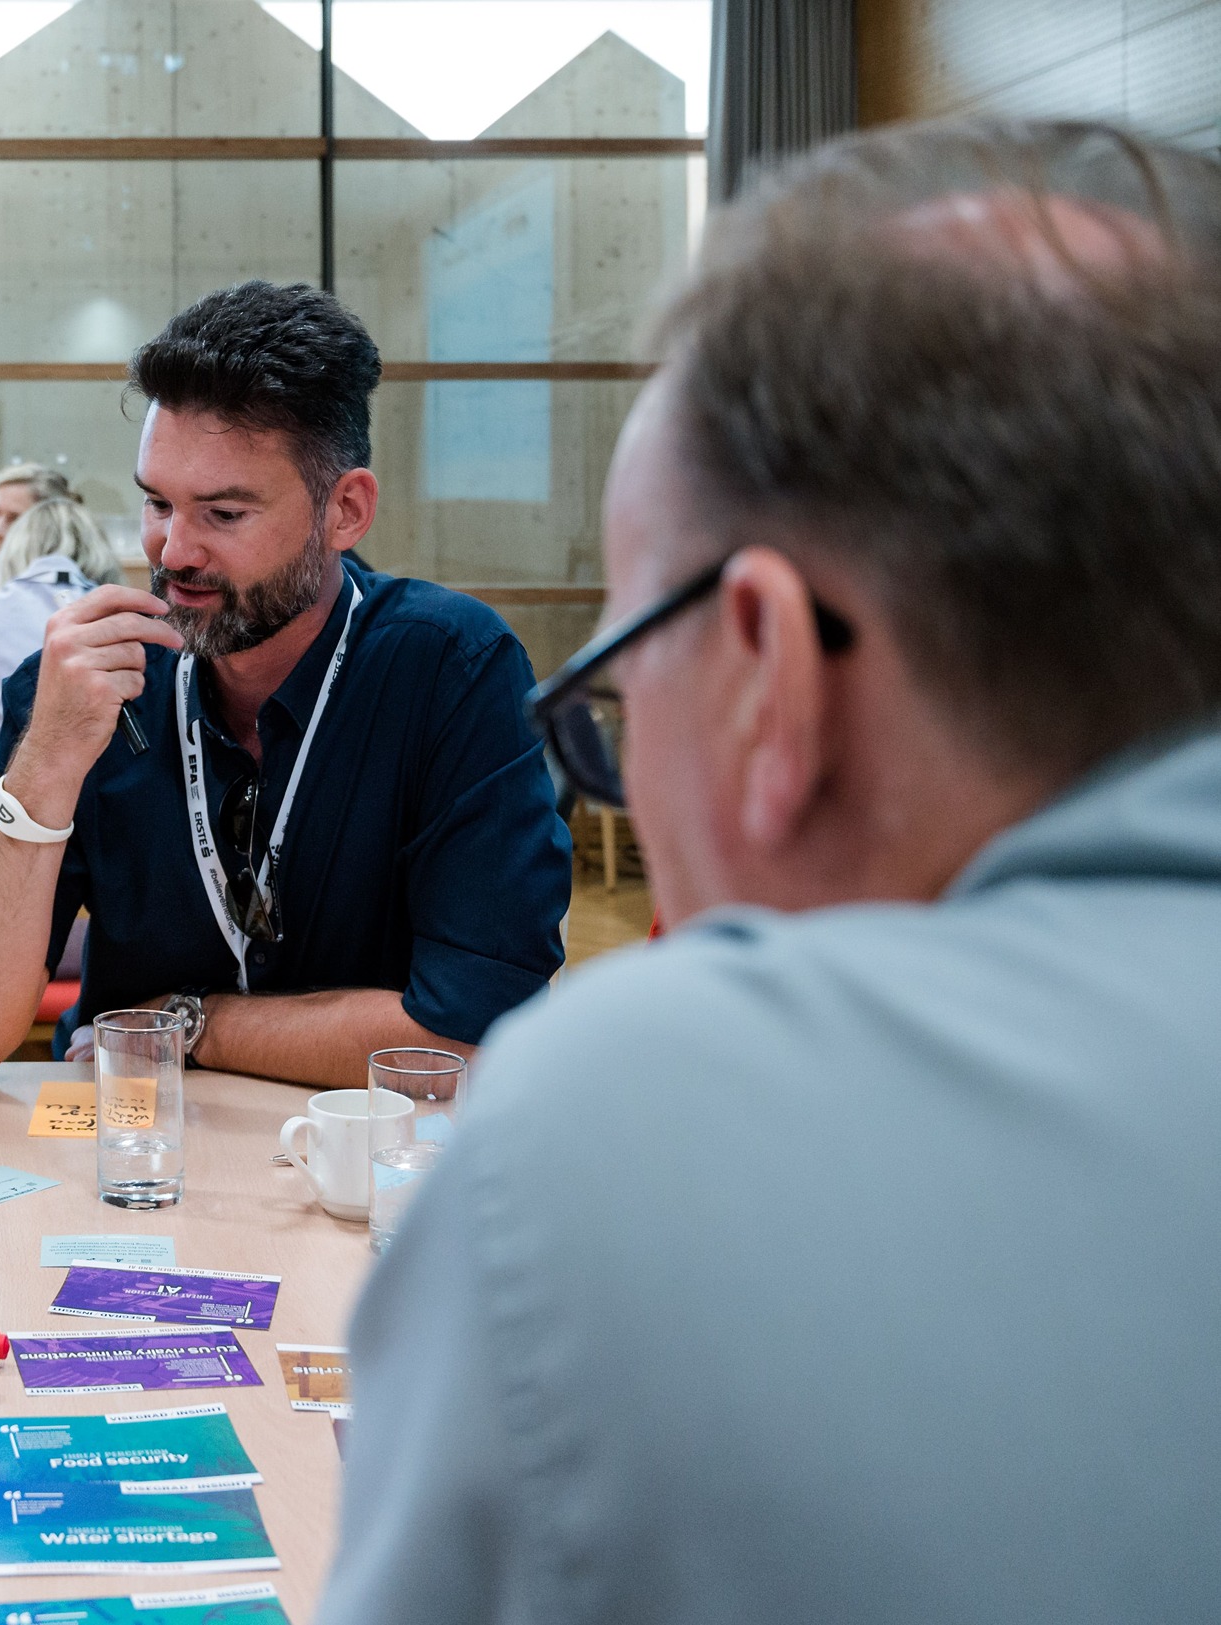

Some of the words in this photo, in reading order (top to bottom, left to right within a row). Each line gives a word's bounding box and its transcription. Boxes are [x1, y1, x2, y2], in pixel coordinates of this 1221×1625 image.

[188, 754, 198, 785] EFA
[194, 811, 208, 846] ERSTE
[209, 868, 237, 936] #believeineurope
[157, 1284, 183, 1294] AI
[181, 1292, 214, 1301] THREAT
[51, 1306, 95, 1316] INSIGHT
[99, 1313, 153, 1321] VISEGRAD
[113, 1349, 132, 1358] on
[136, 1344, 185, 1358] rivalry
[187, 1344, 239, 1355] EU-US
[292, 1366, 344, 1375] crisis
[82, 1384, 140, 1393] VISEGRAD
[109, 1411, 168, 1422] VISEGRAD
[175, 1405, 224, 1416] INSIGHT
[49, 1456, 103, 1469] Food
[104, 1451, 190, 1466] security
[62, 1450, 101, 1460] THREAT
[105, 1448, 169, 1458] PERCEPTION
[124, 1484, 189, 1493] VISEGRAD
[196, 1480, 248, 1490] INSIGHT
[39, 1532, 113, 1546] Water
[115, 1530, 219, 1545] shortage
